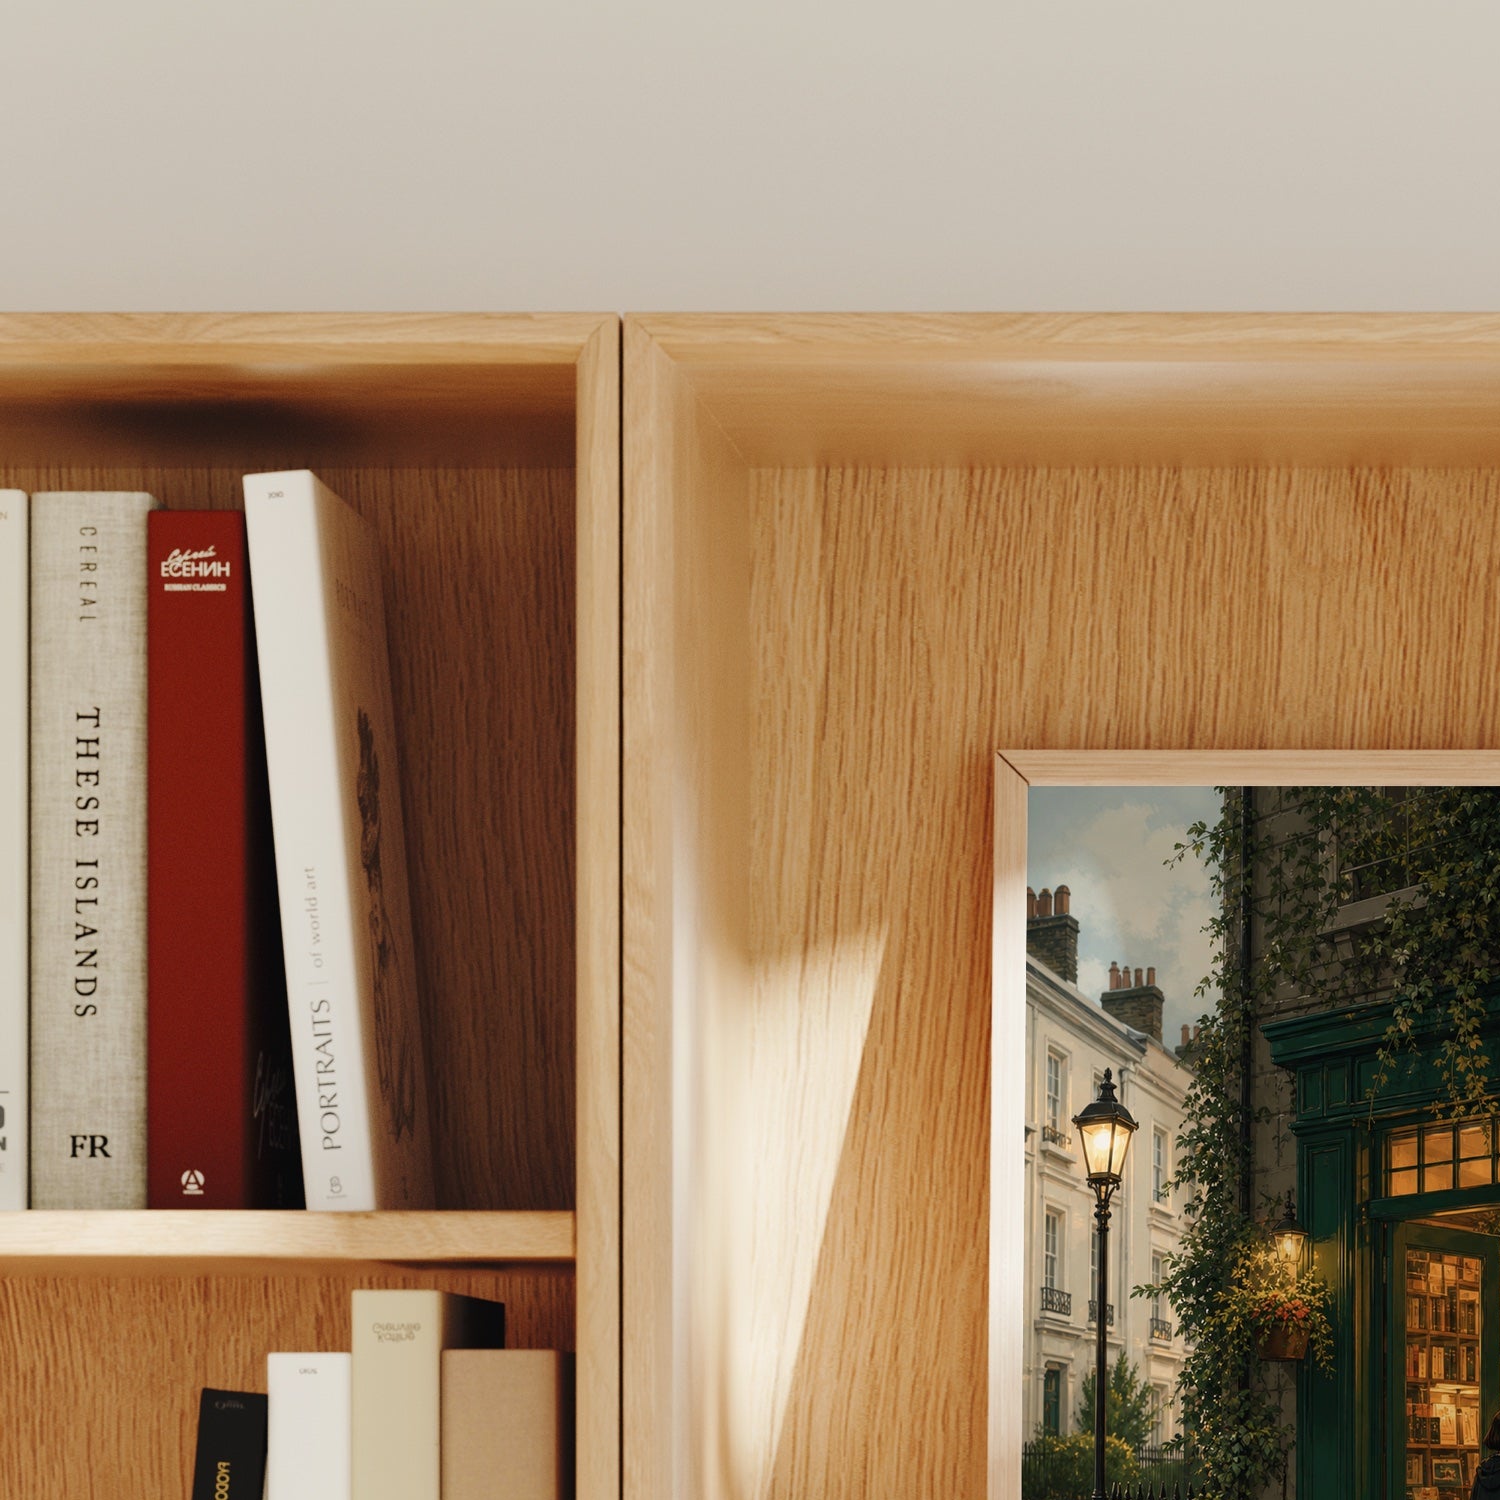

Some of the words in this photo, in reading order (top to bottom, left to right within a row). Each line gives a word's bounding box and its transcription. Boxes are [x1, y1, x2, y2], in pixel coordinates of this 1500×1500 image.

[79, 525, 97, 623] CEREAL
[160, 560, 231, 578] ЕСЕНИН
[75, 706, 101, 838] THESE
[304, 867, 316, 891] art
[74, 859, 99, 1018] ISLANDS
[304, 896, 322, 946] world
[309, 951, 324, 968] of
[310, 998, 342, 1151] PORTRAITS
[70, 1134, 112, 1159] FR
